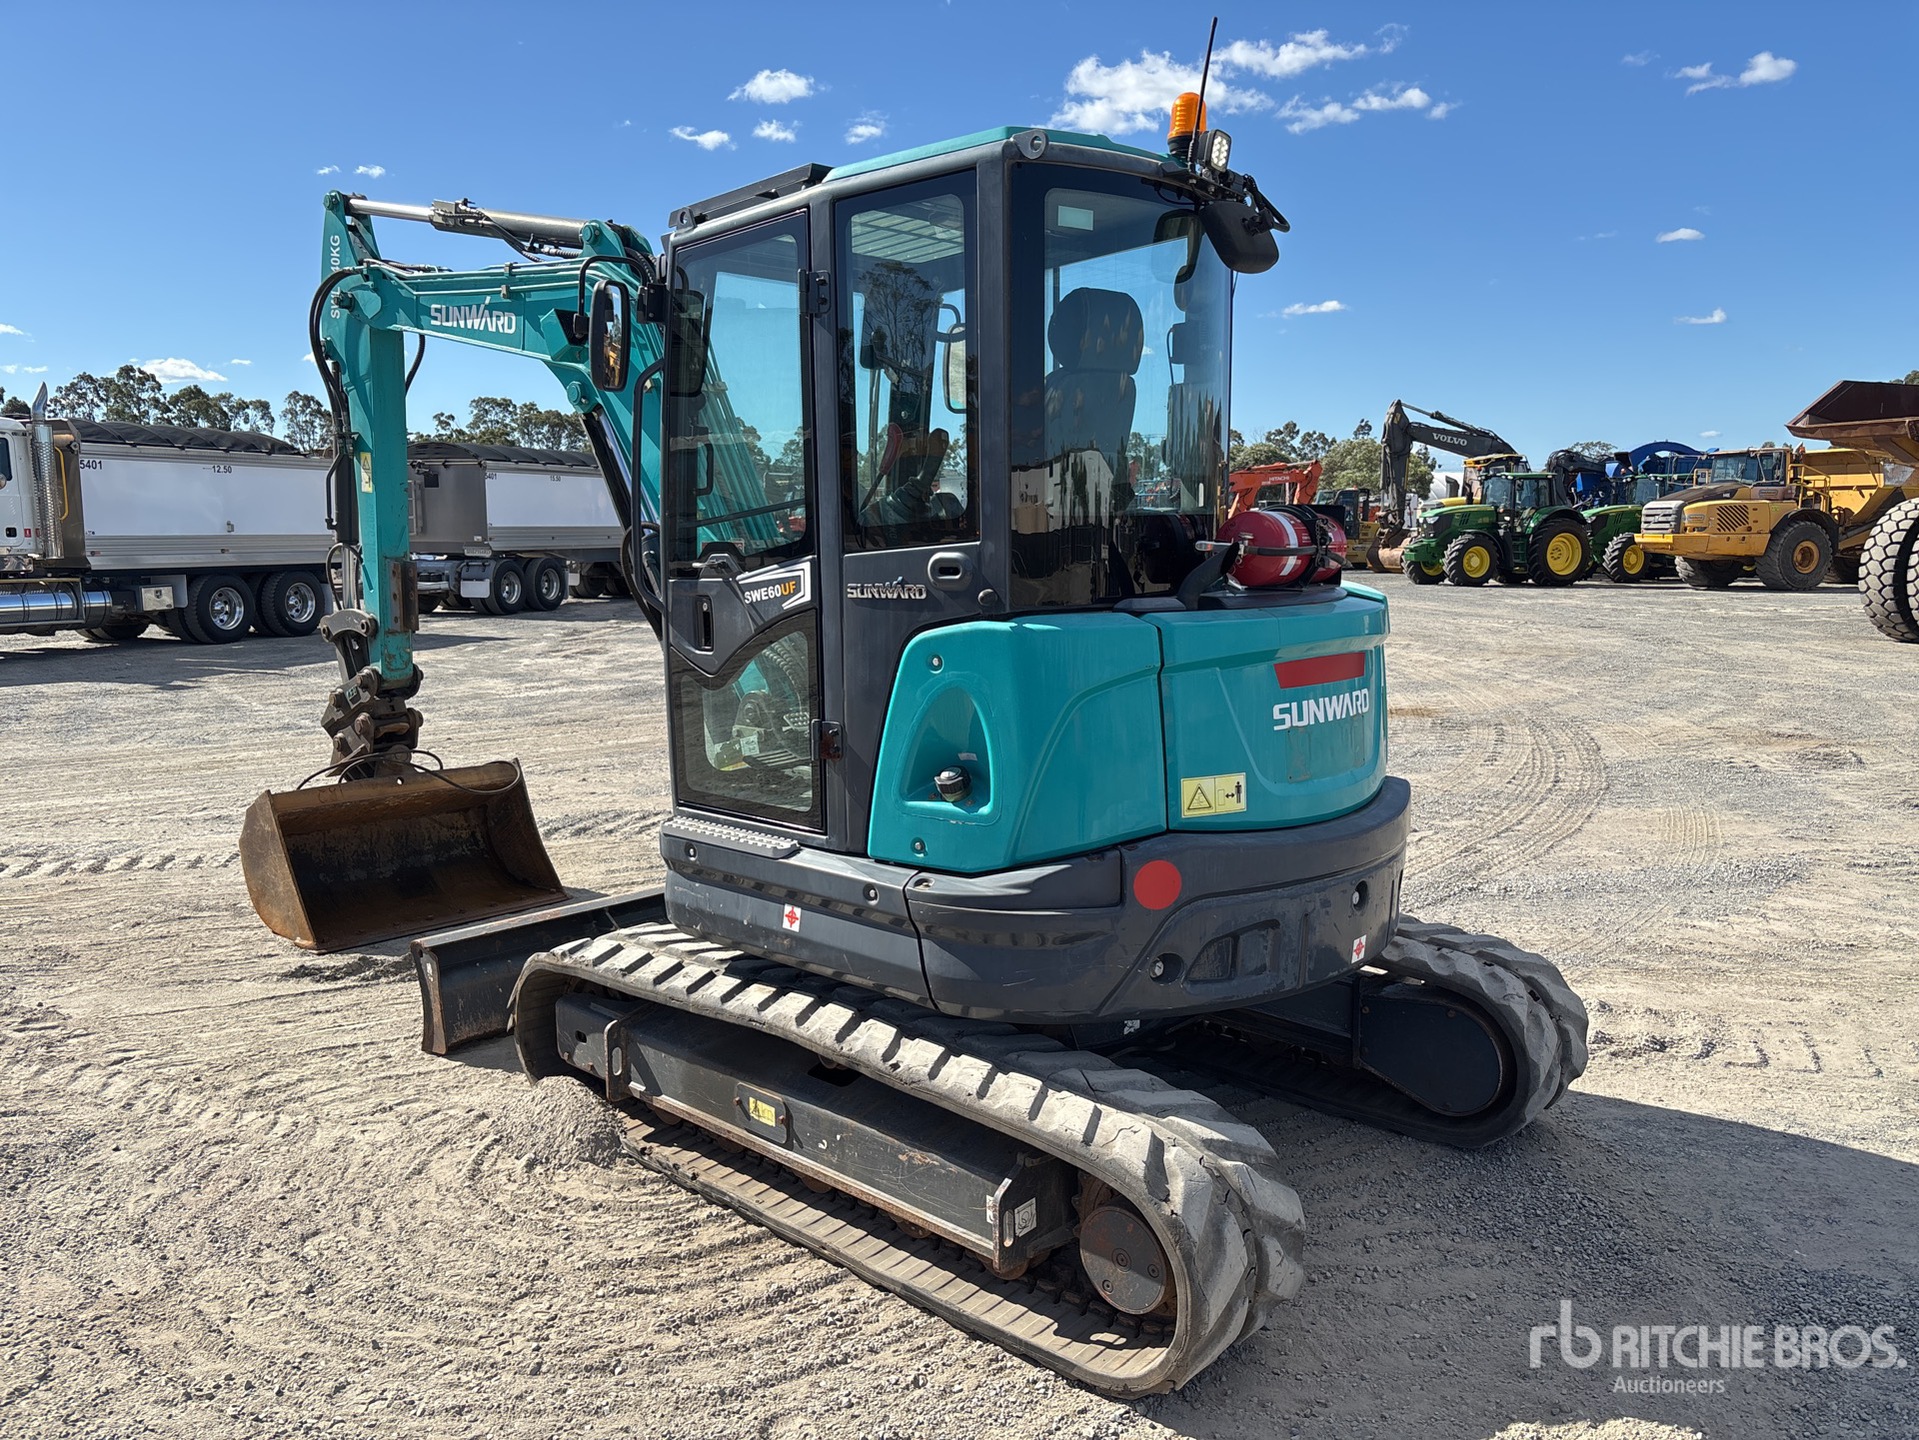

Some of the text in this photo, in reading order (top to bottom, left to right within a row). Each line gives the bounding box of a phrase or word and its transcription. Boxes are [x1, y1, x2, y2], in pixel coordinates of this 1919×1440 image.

[431, 296, 516, 334] SUNWARD
[1432, 433, 1468, 446] VOLVO
[79, 460, 102, 470] 5401
[212, 465, 233, 474] 12.50
[744, 581, 796, 604] SWE60UF
[847, 576, 926, 600] SUNWARD
[1272, 688, 1370, 731] SUNWARD
